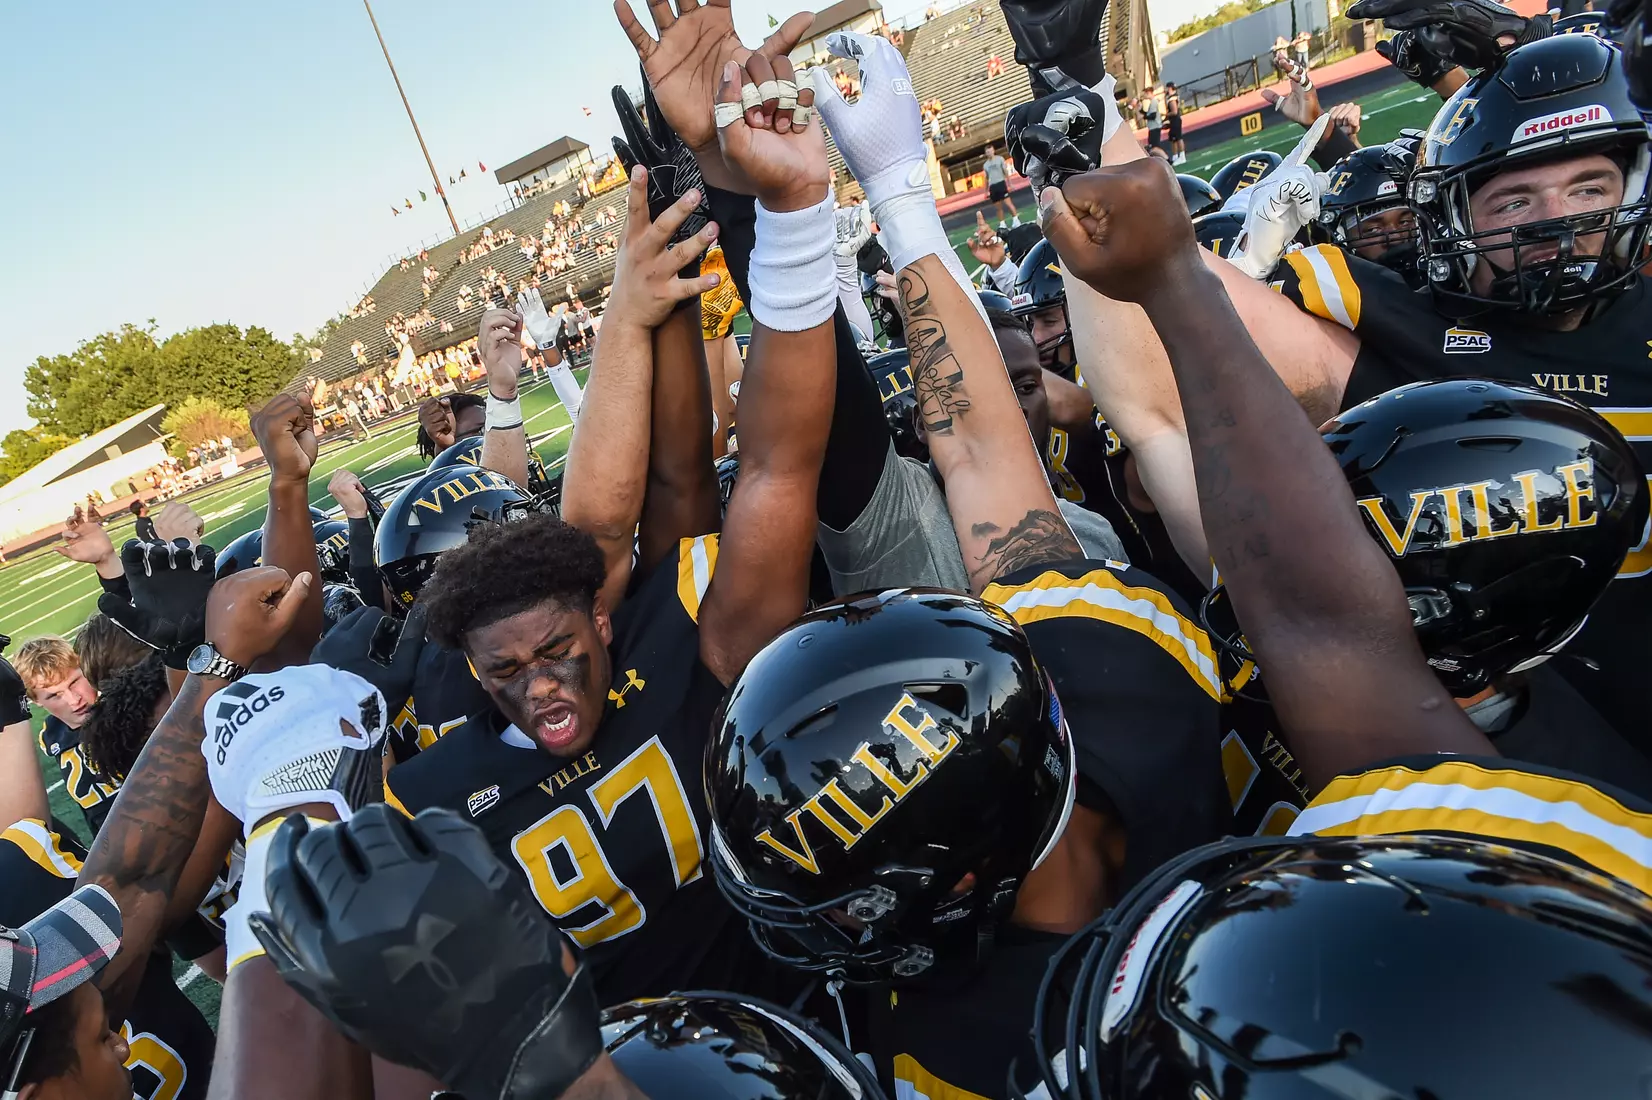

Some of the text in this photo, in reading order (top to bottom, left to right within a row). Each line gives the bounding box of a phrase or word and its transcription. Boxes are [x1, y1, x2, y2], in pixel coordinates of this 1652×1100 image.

[1243, 117, 1258, 131] 10
[1524, 107, 1600, 136] Riddell
[1446, 334, 1489, 347] PSAC
[1532, 373, 1609, 397] VILLE
[1356, 457, 1599, 557] VILLE
[216, 685, 285, 766] adidas
[537, 750, 602, 798] VILLE
[754, 690, 963, 876] VILLE
[468, 789, 498, 811] PSAC
[510, 734, 705, 950] 97
